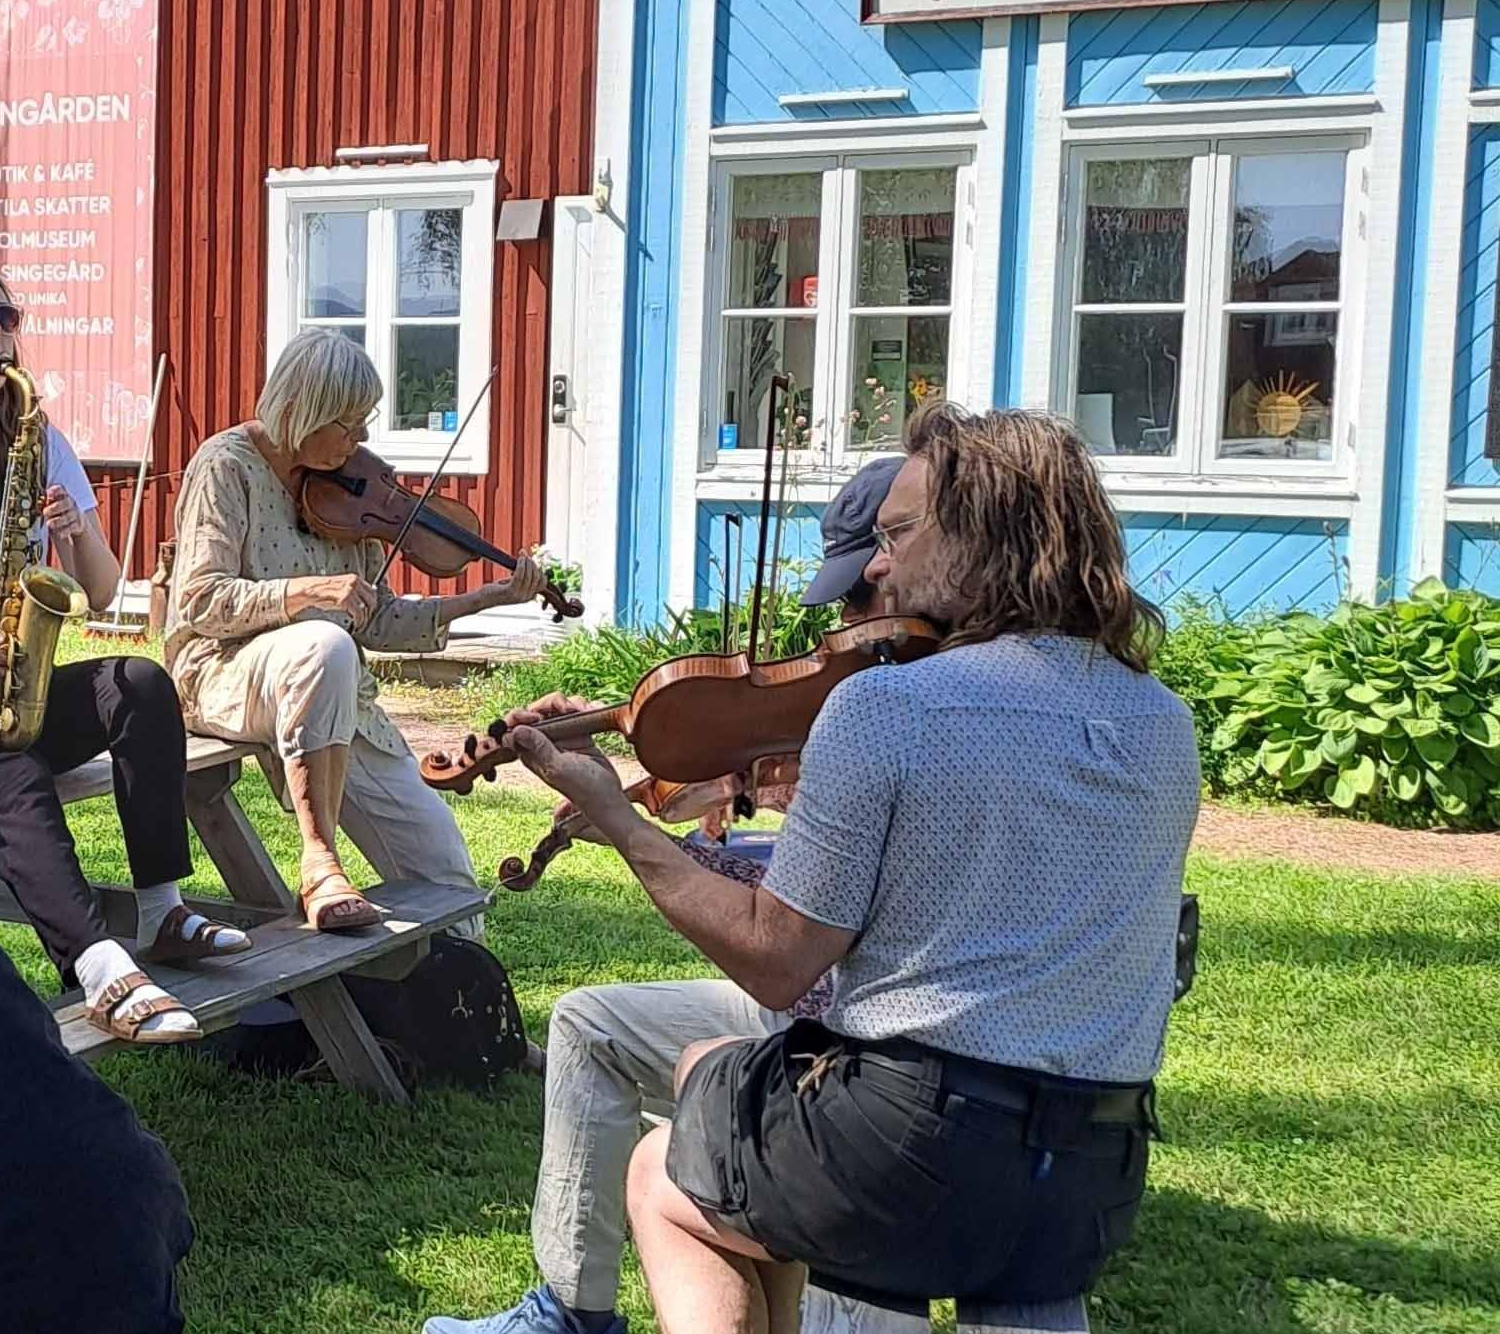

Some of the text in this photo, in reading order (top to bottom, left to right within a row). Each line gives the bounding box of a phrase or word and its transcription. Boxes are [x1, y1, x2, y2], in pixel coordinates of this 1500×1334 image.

[34, 163, 45, 182] &
[51, 159, 95, 182] KAFÉ
[34, 195, 111, 216] SKATTER
[1, 259, 105, 282] SINGEGÅRD
[28, 291, 67, 306] UNIKA
[21, 314, 114, 335] ÅLNINGAR
